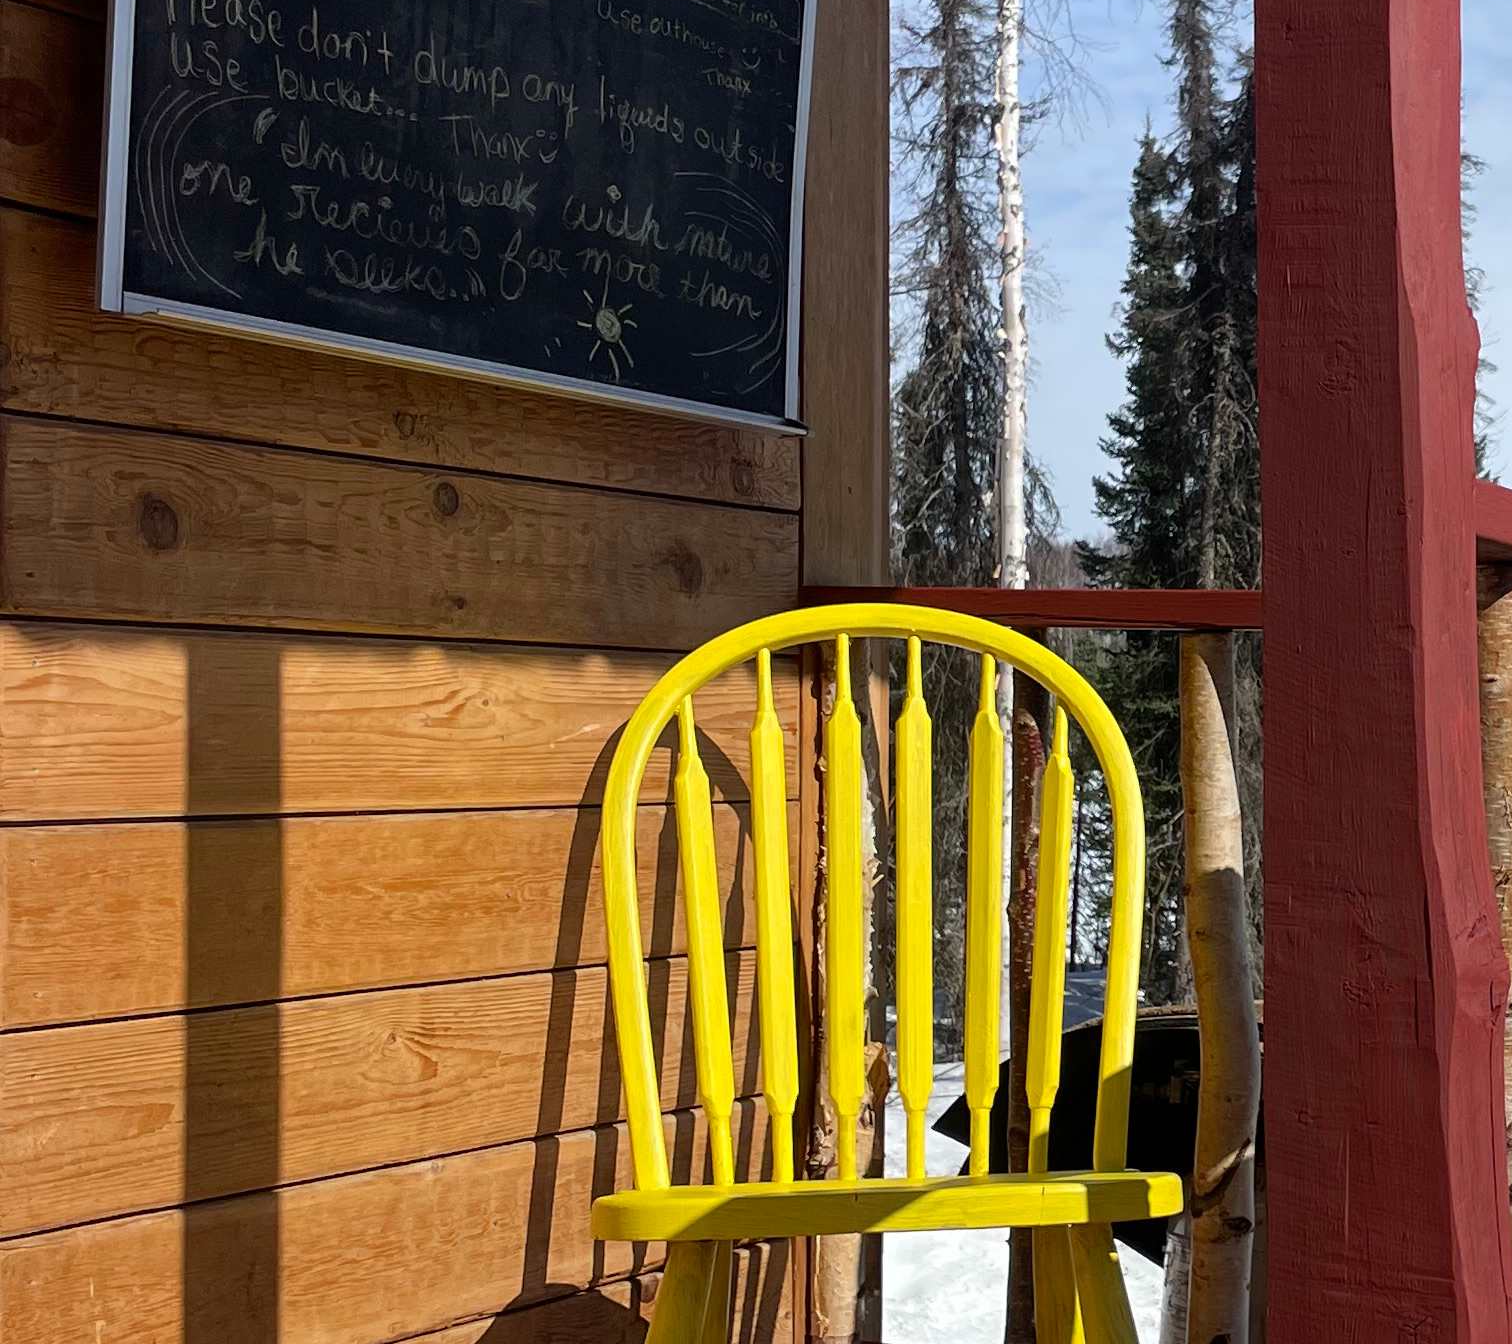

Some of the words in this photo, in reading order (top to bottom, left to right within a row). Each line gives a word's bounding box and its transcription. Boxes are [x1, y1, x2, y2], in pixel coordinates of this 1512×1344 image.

[299, 6, 393, 75] don't
[414, 31, 511, 111] dump
[522, 74, 579, 139] any
[600, 74, 684, 154] liquids
[694, 128, 785, 183] outside
[438, 115, 535, 165] Thanx
[179, 159, 259, 205] one
[562, 184, 668, 251] with
